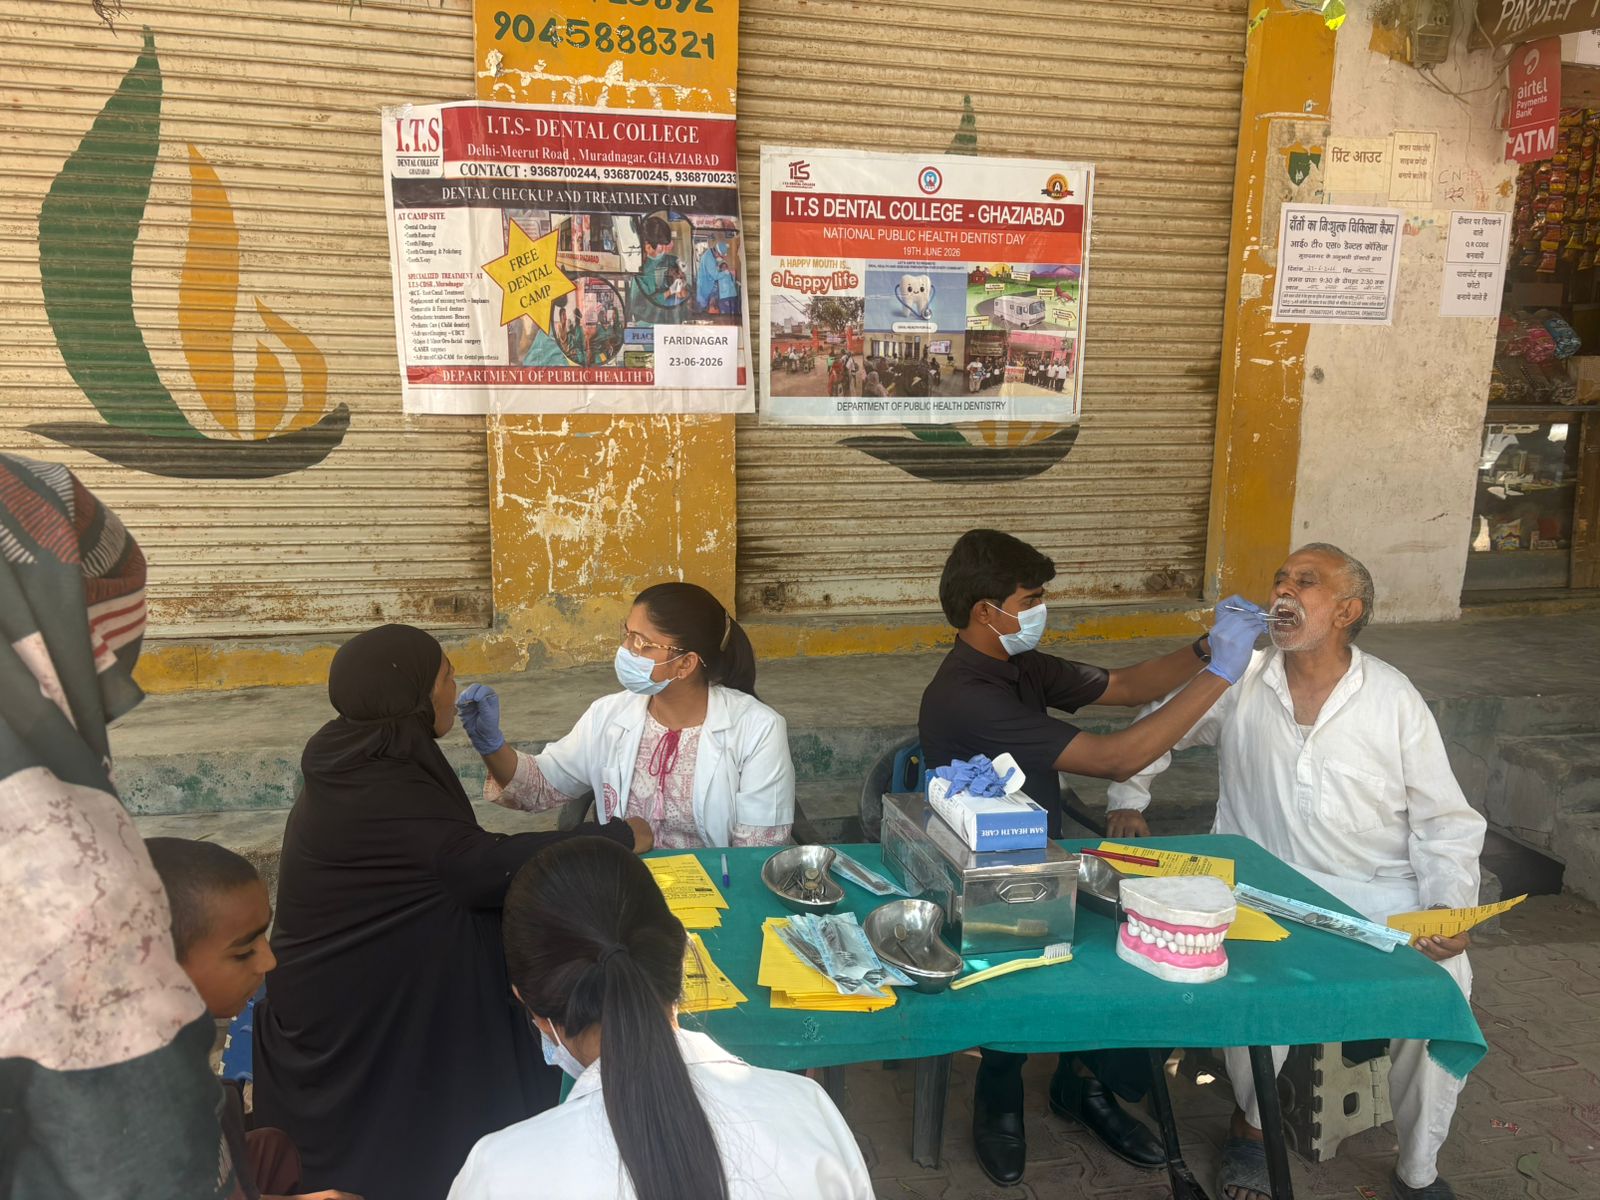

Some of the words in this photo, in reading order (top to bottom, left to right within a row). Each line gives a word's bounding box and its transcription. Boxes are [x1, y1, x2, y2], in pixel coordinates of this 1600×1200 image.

[493, 10, 715, 60] 9045888321
[1517, 77, 1548, 99] airtel
[1516, 95, 1548, 110] Payments
[1515, 109, 1533, 119] Bank
[396, 117, 440, 153] I.T.S
[487, 115, 531, 136] I.T.S-
[536, 118, 609, 140] DENTAL
[613, 122, 700, 144] COLLEGE
[1512, 126, 1555, 157] ATM
[396, 158, 417, 167] DENTAL
[418, 158, 438, 167] COLLEGE
[467, 143, 540, 159] Delhi-Meerut
[579, 149, 646, 165] Muradnagar,
[648, 151, 719, 166] GHAZIABAD
[1352, 150, 1383, 164] आउट
[460, 163, 520, 178] CONTACT
[530, 166, 600, 181] 9368700244,
[604, 169, 672, 183] 9368700245,
[442, 186, 490, 200] DENTAL
[492, 188, 554, 202] CHECKUP
[555, 190, 581, 203] AND
[584, 191, 659, 205] TREATMENT
[662, 194, 697, 206] CAMP
[407, 212, 428, 220] CAMP
[430, 212, 446, 220] SITE
[786, 196, 819, 216] I.T.S
[824, 198, 886, 219] DENTAL
[889, 202, 963, 222] COLLEGE
[978, 204, 1064, 226] GHAZIABAD
[1308, 220, 1317, 232] का
[824, 227, 875, 240] NATIONAL
[878, 229, 916, 241] PUBLIC
[918, 230, 958, 242] HEALTH
[960, 232, 1004, 244] DENTIST
[1006, 233, 1026, 245] DAY
[508, 248, 540, 272] FREE
[904, 246, 921, 256] 19TH
[923, 248, 942, 256] JUNE
[944, 248, 961, 257] 2026
[780, 260, 785, 268] A
[786, 258, 810, 268] HAPPY
[812, 258, 838, 269] MOUTH
[507, 264, 553, 294] DENTAL
[772, 274, 782, 286] a
[784, 272, 831, 294] happy
[833, 272, 859, 290] life
[519, 284, 551, 309] CAMP
[663, 336, 728, 346] FARIDNAGAR
[669, 357, 724, 368] 23-06-2026
[442, 370, 526, 383] DEPARTMENT
[528, 370, 545, 382] OF
[548, 370, 593, 383] PUBLIC
[595, 370, 642, 383] HEALTH
[837, 402, 889, 412] DEPARTMENT
[891, 402, 902, 411] OF
[904, 402, 931, 411] PUBLIC
[933, 402, 962, 411] HEALTH
[964, 402, 1007, 411] DENTISTRY
[1001, 828, 1028, 836] HEALTH
